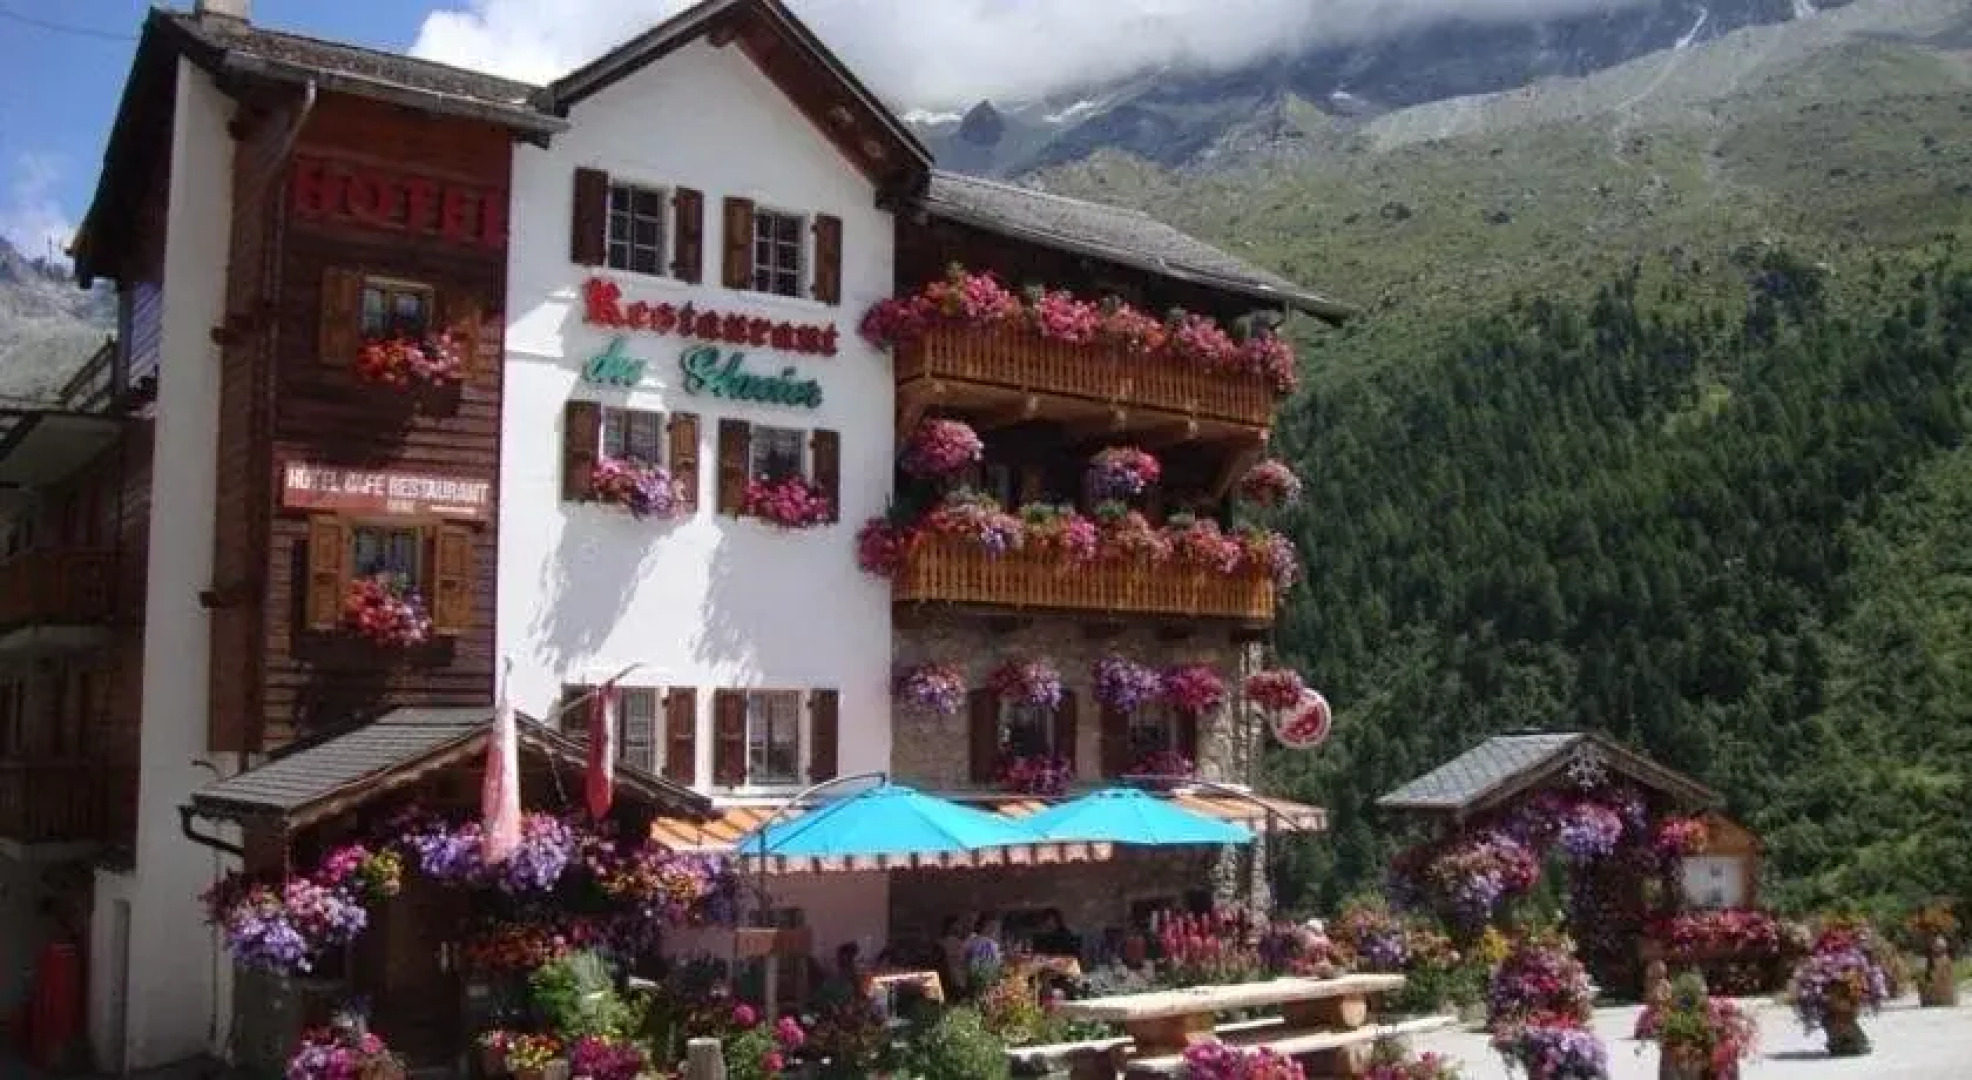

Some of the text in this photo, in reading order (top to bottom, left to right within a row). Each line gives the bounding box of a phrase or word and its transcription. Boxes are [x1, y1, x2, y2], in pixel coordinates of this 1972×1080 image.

[296, 160, 506, 252] HOTEL
[581, 277, 839, 357] Restaurant
[581, 337, 822, 408] du Glacier
[389, 475, 490, 504] RESTAURANT
